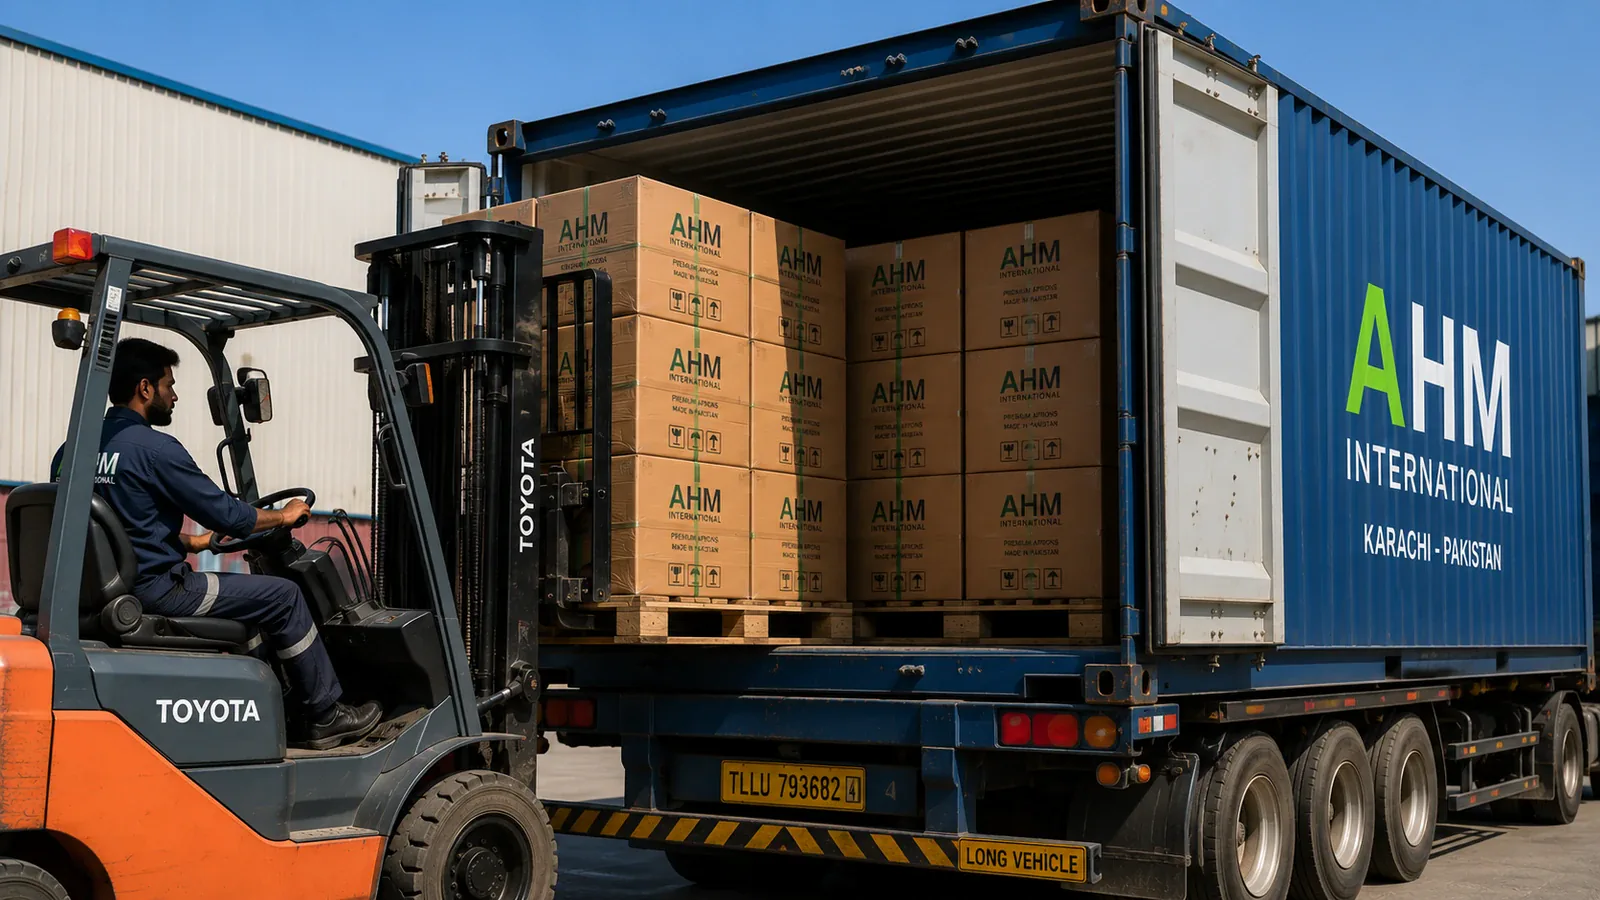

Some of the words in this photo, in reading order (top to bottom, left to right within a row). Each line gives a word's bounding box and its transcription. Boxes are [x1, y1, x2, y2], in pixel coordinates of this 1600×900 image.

[559, 212, 608, 243] AHM
[670, 212, 721, 249] AHM
[780, 245, 822, 278] AHM
[1000, 239, 1060, 270] AHM
[872, 259, 925, 288] AHM
[1000, 264, 1060, 279] INTERNATIONAL
[670, 348, 721, 380] AHM
[1346, 283, 1511, 458] AHM
[780, 371, 822, 400] AHM
[872, 379, 925, 404] AHM
[1000, 365, 1060, 394] AHM
[1000, 391, 1060, 403] INTERNATIONAL
[1347, 438, 1513, 514] INTERNATIONAL
[519, 438, 535, 553] TOYOTA
[669, 484, 721, 513] AHM
[780, 497, 822, 522] AHM
[1000, 492, 1061, 518] AHM
[669, 511, 721, 524] INTERNATIONAL
[872, 499, 925, 523] AHM
[1000, 518, 1062, 528] INTERNATIONAL
[1364, 523, 1431, 562] KARACHI
[1443, 536, 1501, 571] PAKISTAN
[156, 699, 260, 723] TOYOTA
[729, 771, 770, 796] TLLU
[778, 774, 841, 801] 793682
[967, 847, 1007, 867] LONG
[1013, 851, 1078, 874] VEHICLE
